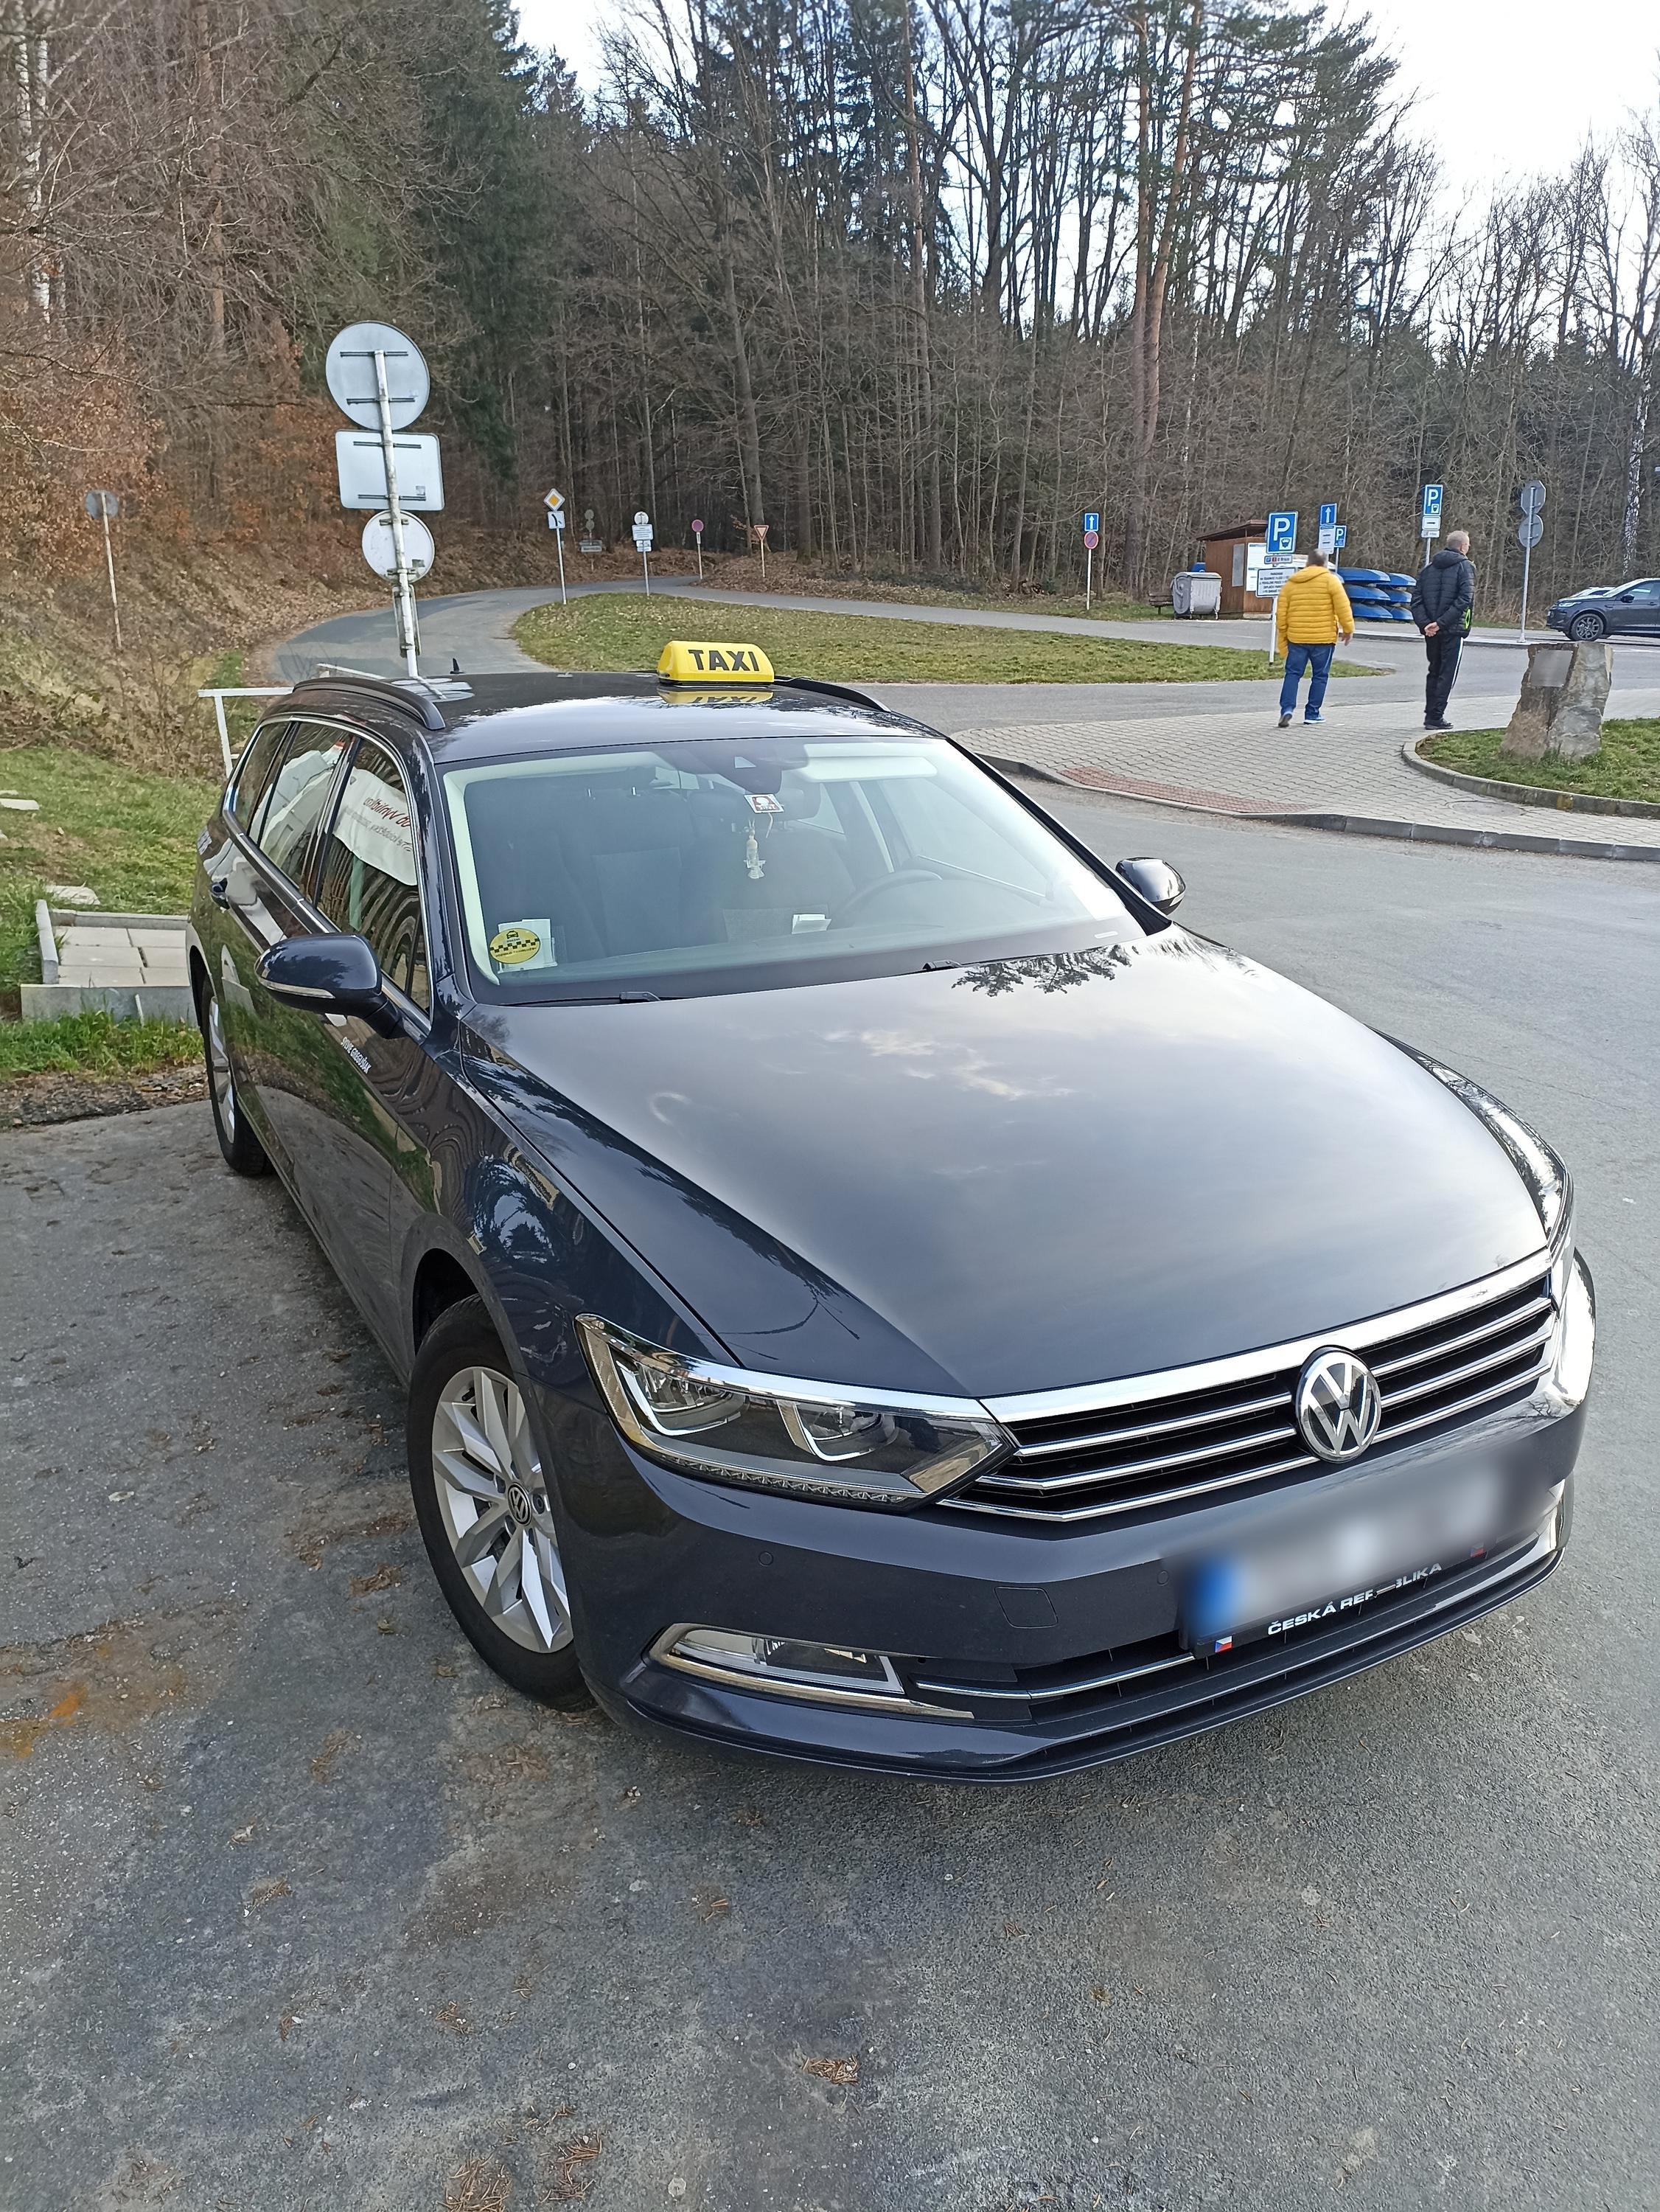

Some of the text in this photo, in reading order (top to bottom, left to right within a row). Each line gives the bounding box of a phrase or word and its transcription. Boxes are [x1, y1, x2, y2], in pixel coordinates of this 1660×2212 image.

[1428, 489, 1438, 507] P
[1273, 518, 1291, 541] P
[1336, 528, 1344, 540] P
[688, 649, 759, 672] TAXI
[1267, 1562, 1443, 1635] ČESKÁ REPBLIKA
